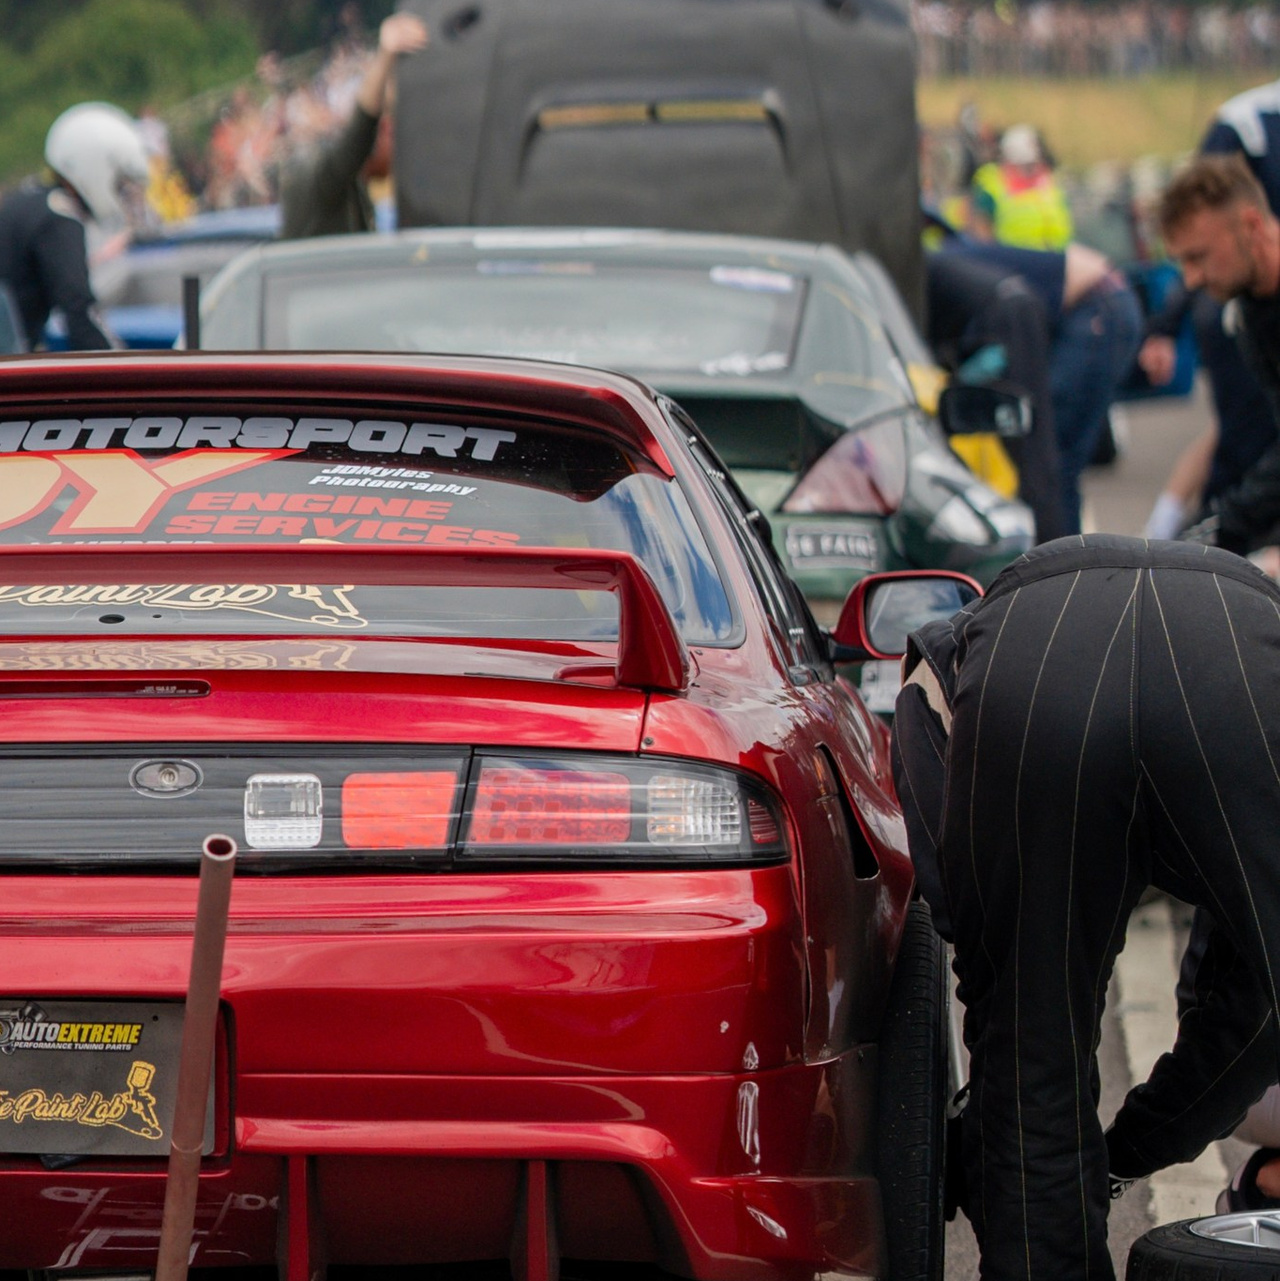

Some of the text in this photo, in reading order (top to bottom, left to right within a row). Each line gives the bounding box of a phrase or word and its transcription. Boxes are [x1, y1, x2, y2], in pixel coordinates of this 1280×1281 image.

[322, 464, 434, 479] JDMyles
[308, 475, 477, 495] Photography
[186, 492, 453, 520] ENGINE
[165, 515, 520, 546] SERVICES
[10, 1022, 141, 1043] AUTOEXTREME
[13, 1042, 72, 1050] PERFORMANCE
[105, 1043, 132, 1051] PARTS
[13, 1088, 86, 1123] Paint
[78, 1091, 128, 1126] Lab
